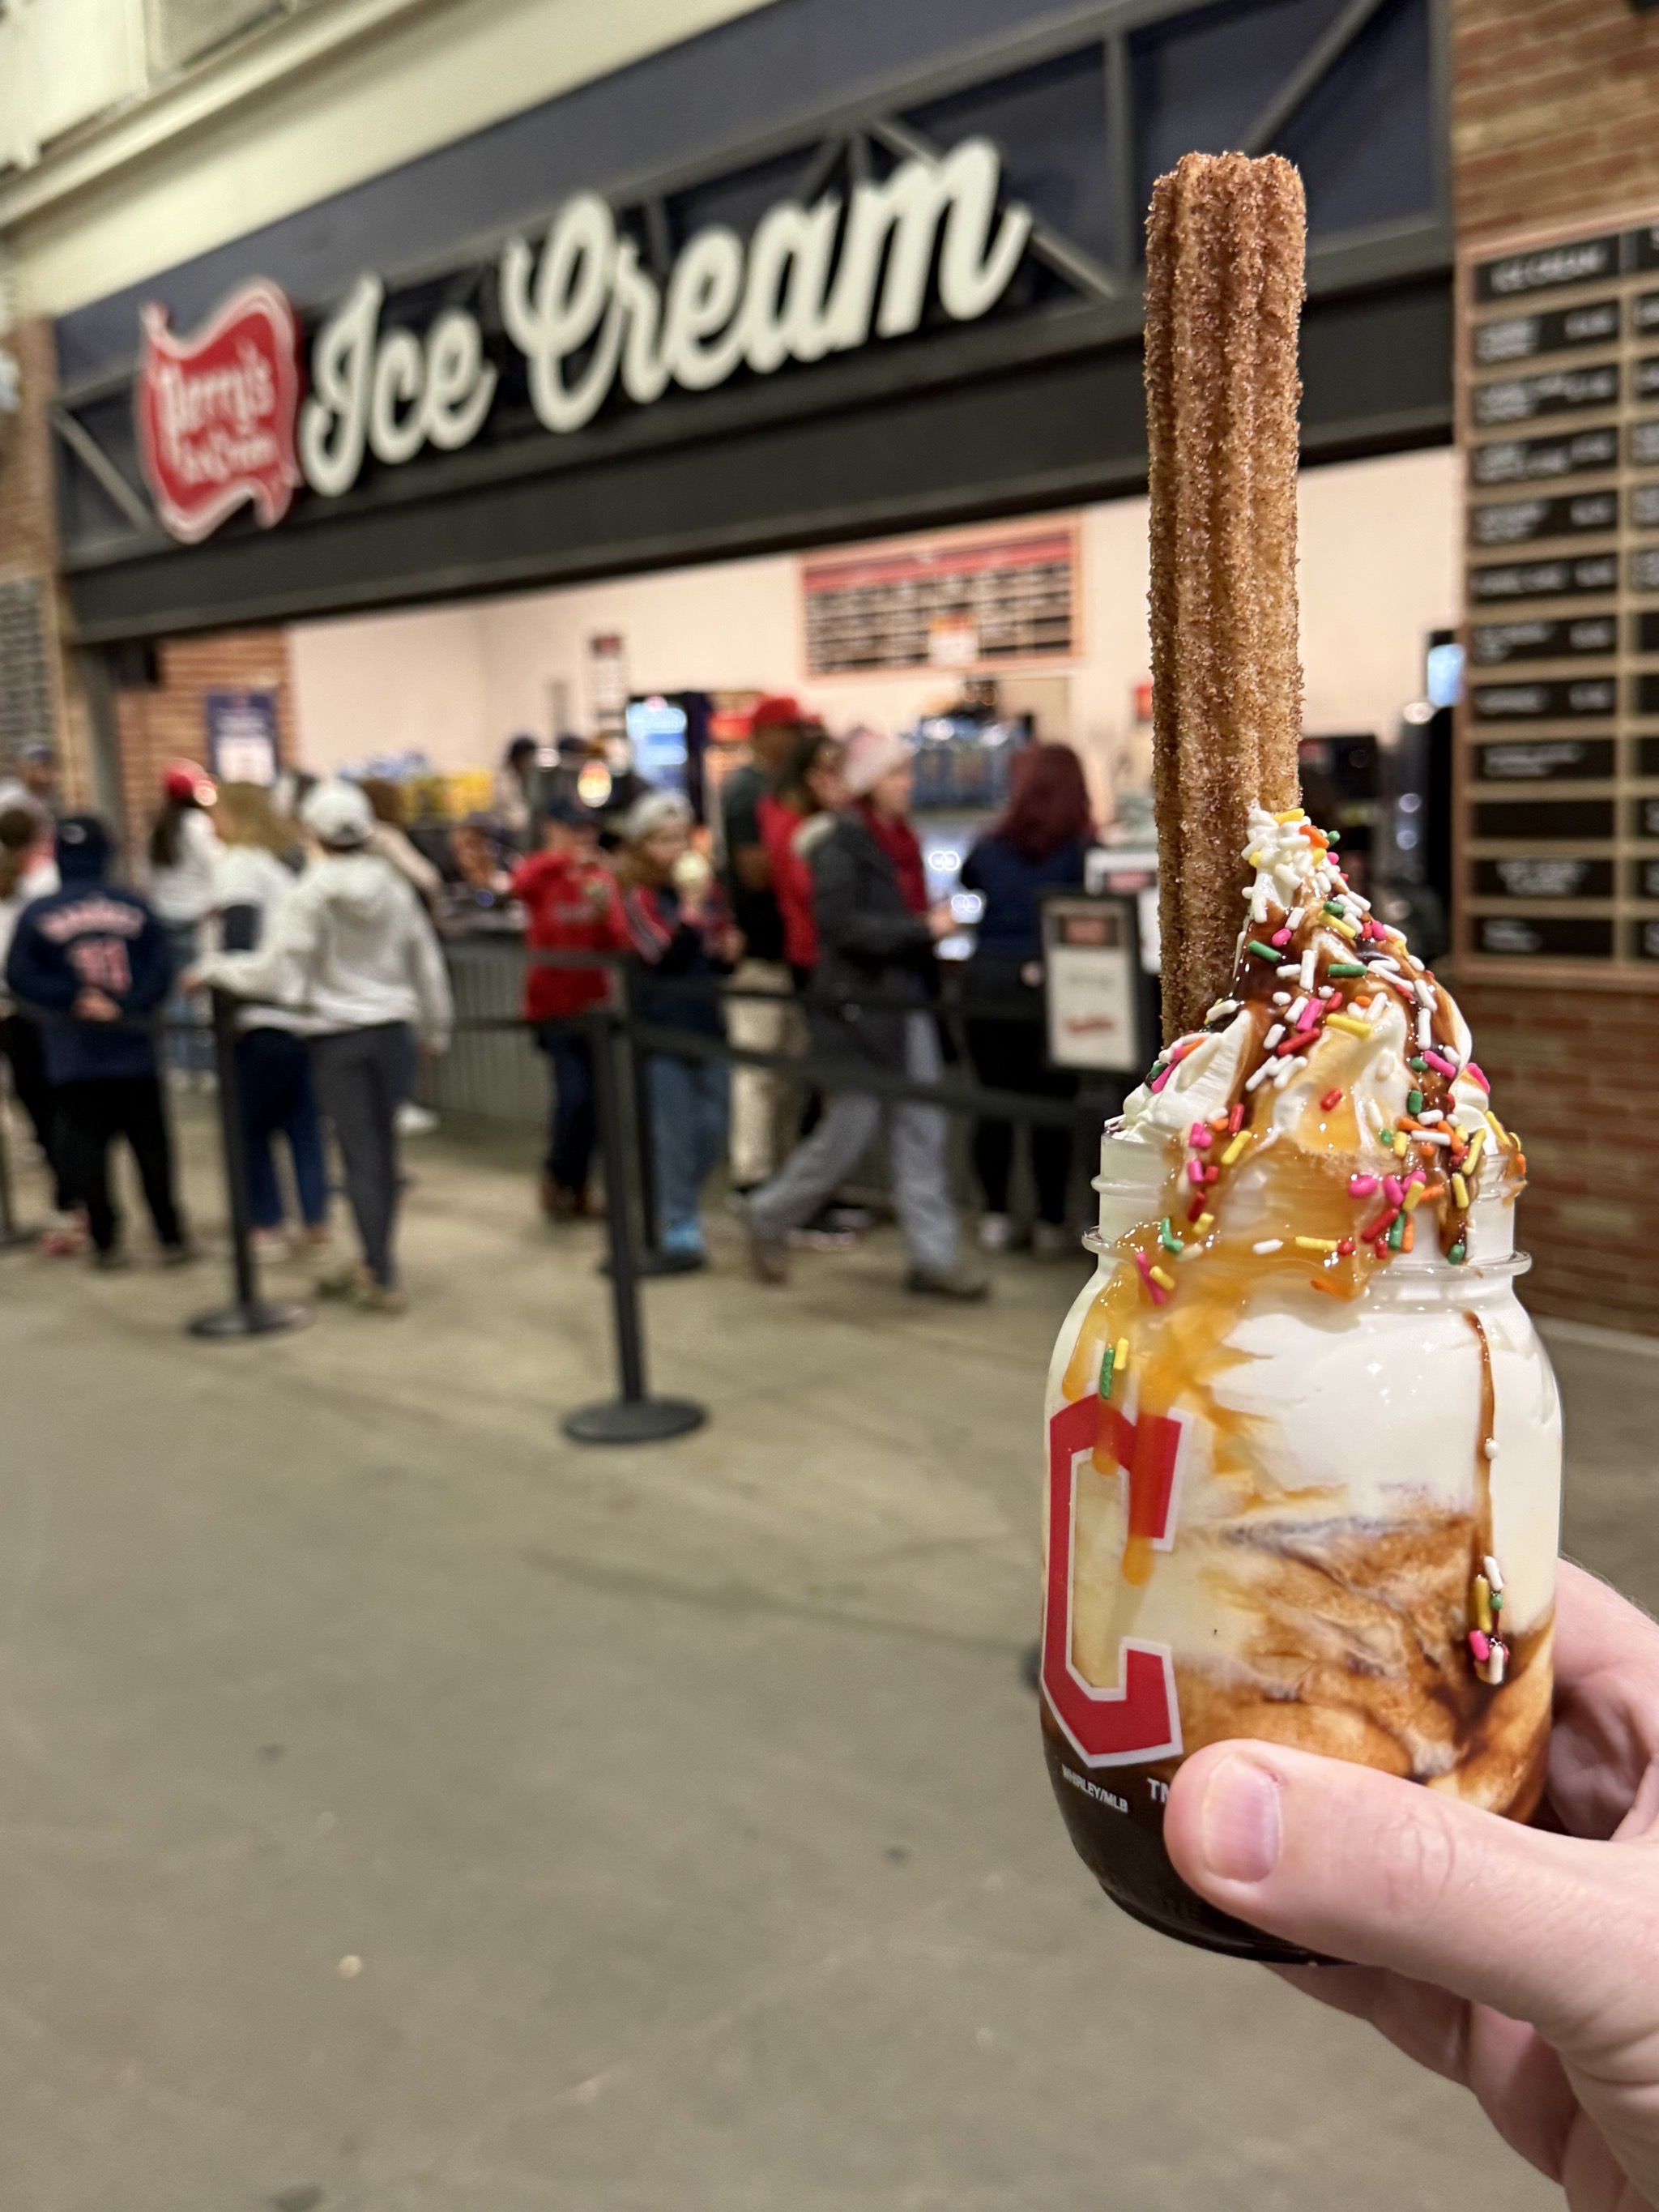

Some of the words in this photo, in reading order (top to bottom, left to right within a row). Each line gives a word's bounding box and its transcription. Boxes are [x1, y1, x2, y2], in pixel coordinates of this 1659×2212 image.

[299, 270, 499, 497] Ice
[499, 136, 1032, 433] Cream
[1041, 1394, 1195, 1768] C
[1061, 1763, 1128, 1813] WHIRLEY/MLB
